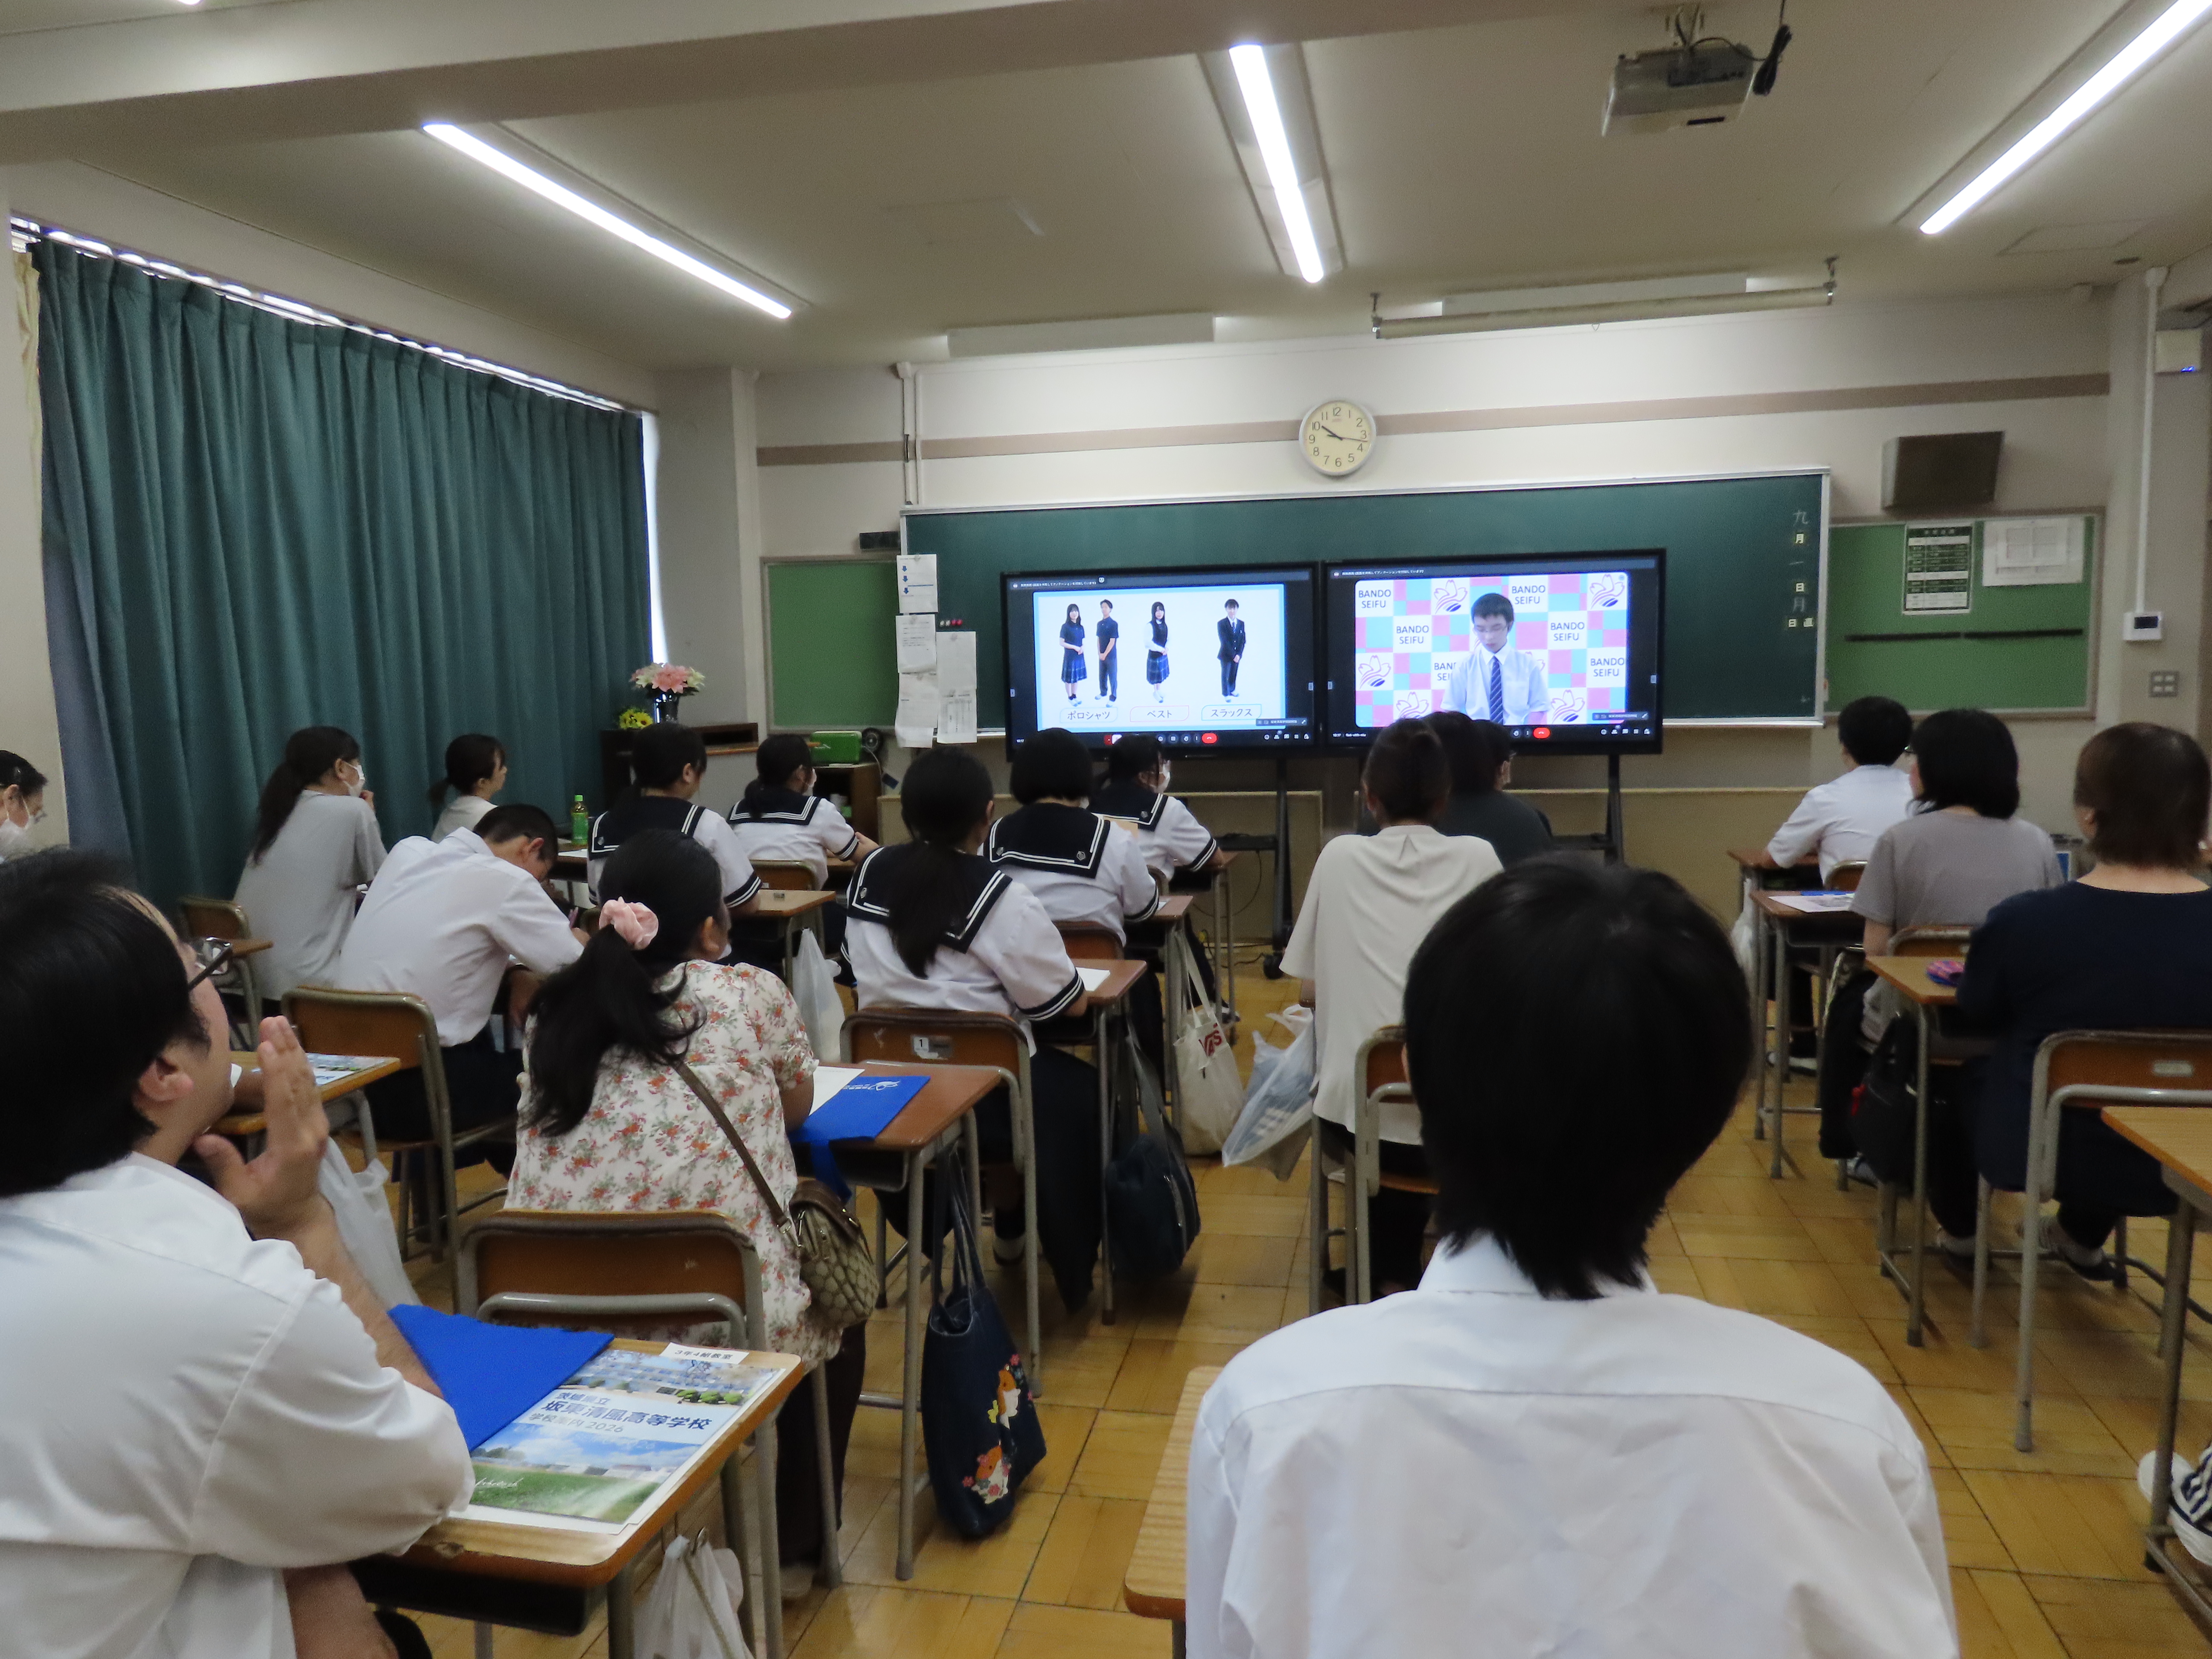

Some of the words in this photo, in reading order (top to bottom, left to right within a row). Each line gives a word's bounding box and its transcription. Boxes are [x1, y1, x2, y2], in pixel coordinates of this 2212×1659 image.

[1321, 412, 1328, 420] 11
[1333, 407, 1341, 416] 12
[1348, 410, 1350, 418] 1
[1312, 421, 1320, 431] 10
[1356, 418, 1362, 427] 2
[1360, 430, 1367, 439] 3
[1309, 435, 1315, 444] 9
[1313, 447, 1319, 456] 8
[1357, 443, 1363, 452] 4
[1324, 456, 1330, 465] 7
[1335, 458, 1342, 467] 6
[1348, 453, 1354, 463] 5
[1359, 590, 1391, 598] BANDO
[1512, 585, 1545, 594] BANDO
[1515, 596, 1540, 604] SEIFU
[1396, 626, 1429, 634] BANDO
[1551, 622, 1585, 630] BANDO
[1590, 658, 1625, 666] BANDO
[1593, 669, 1619, 677] SEIFU
[1067, 710, 1110, 720] ポロシャツ
[1147, 709, 1172, 719] ベスト
[1211, 708, 1252, 718] スラックス
[919, 1039, 923, 1048] 1
[675, 1350, 733, 1360] 3年4組教室
[541, 1400, 712, 1430] 坂東清風高等学校
[586, 1421, 623, 1433] 2026
